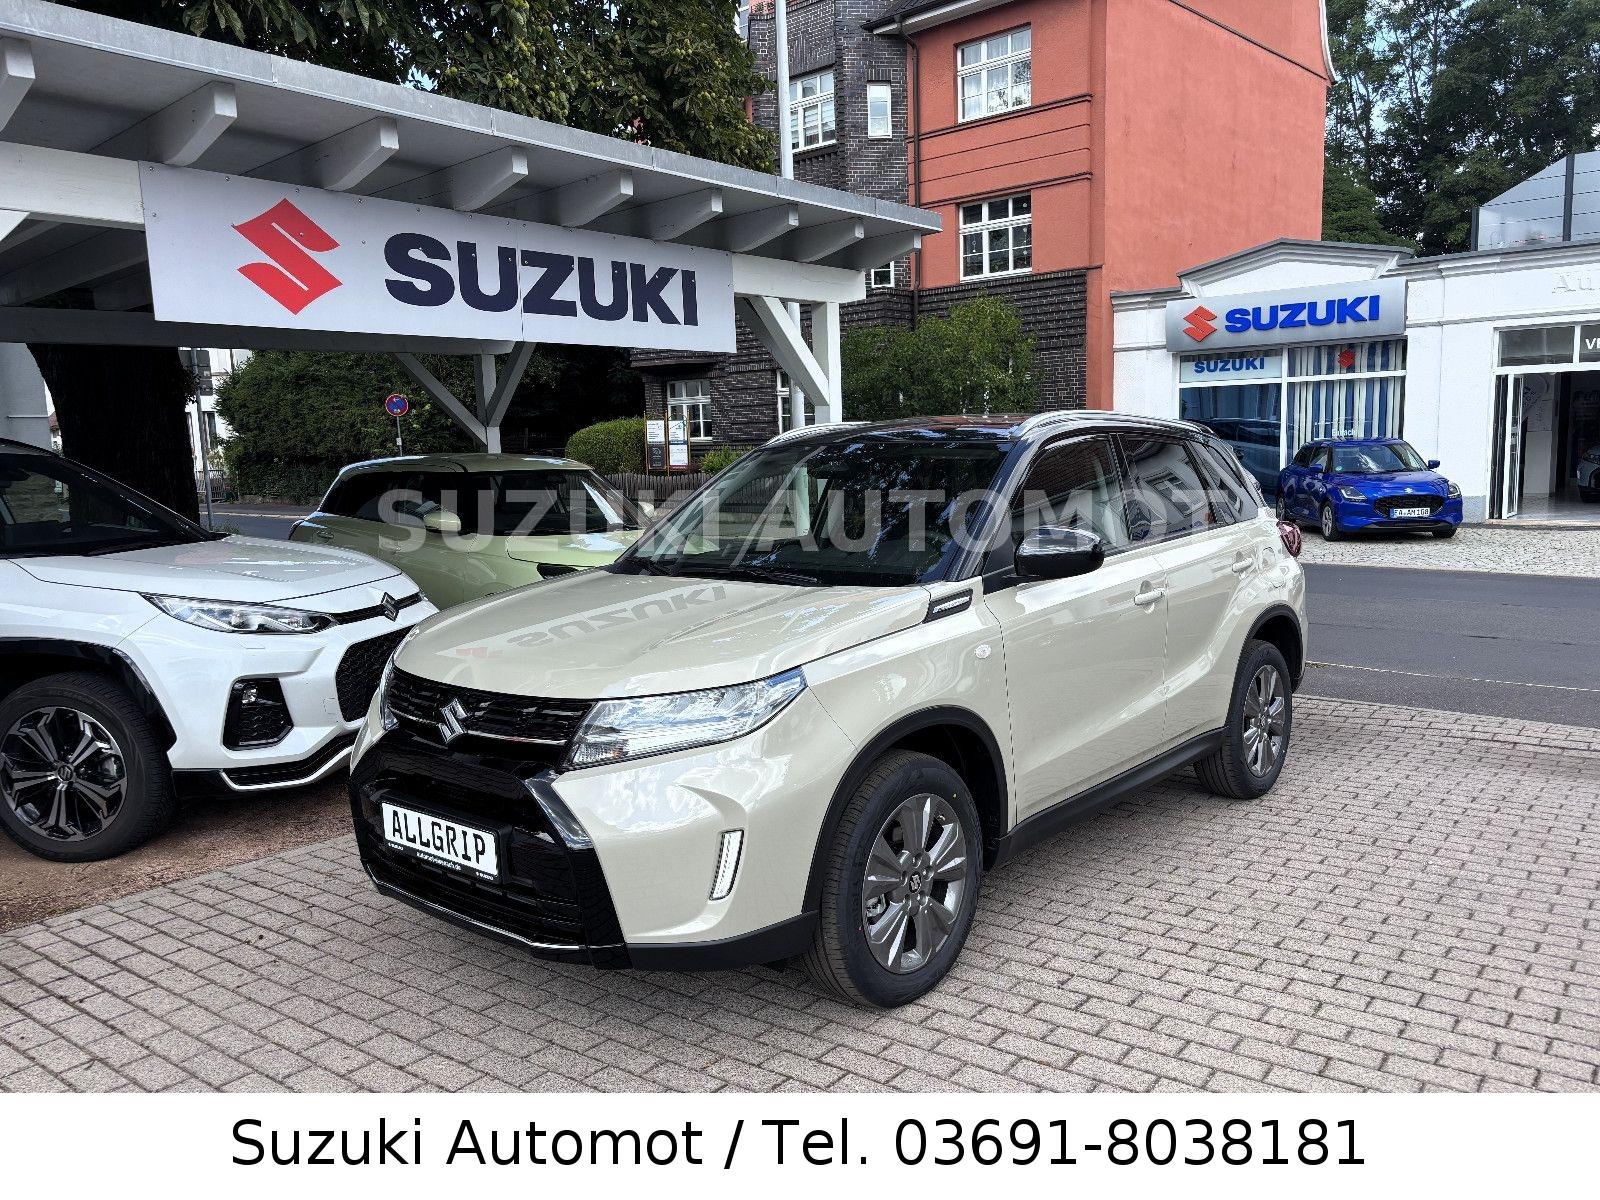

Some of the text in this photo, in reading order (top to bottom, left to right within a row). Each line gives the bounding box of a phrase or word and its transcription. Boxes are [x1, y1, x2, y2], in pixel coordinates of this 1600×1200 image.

[384, 232, 699, 327] SUZUKI
[1225, 294, 1380, 333] SUZUKI
[1194, 356, 1265, 374] SUZUKI
[392, 809, 486, 864] ALLGRIP
